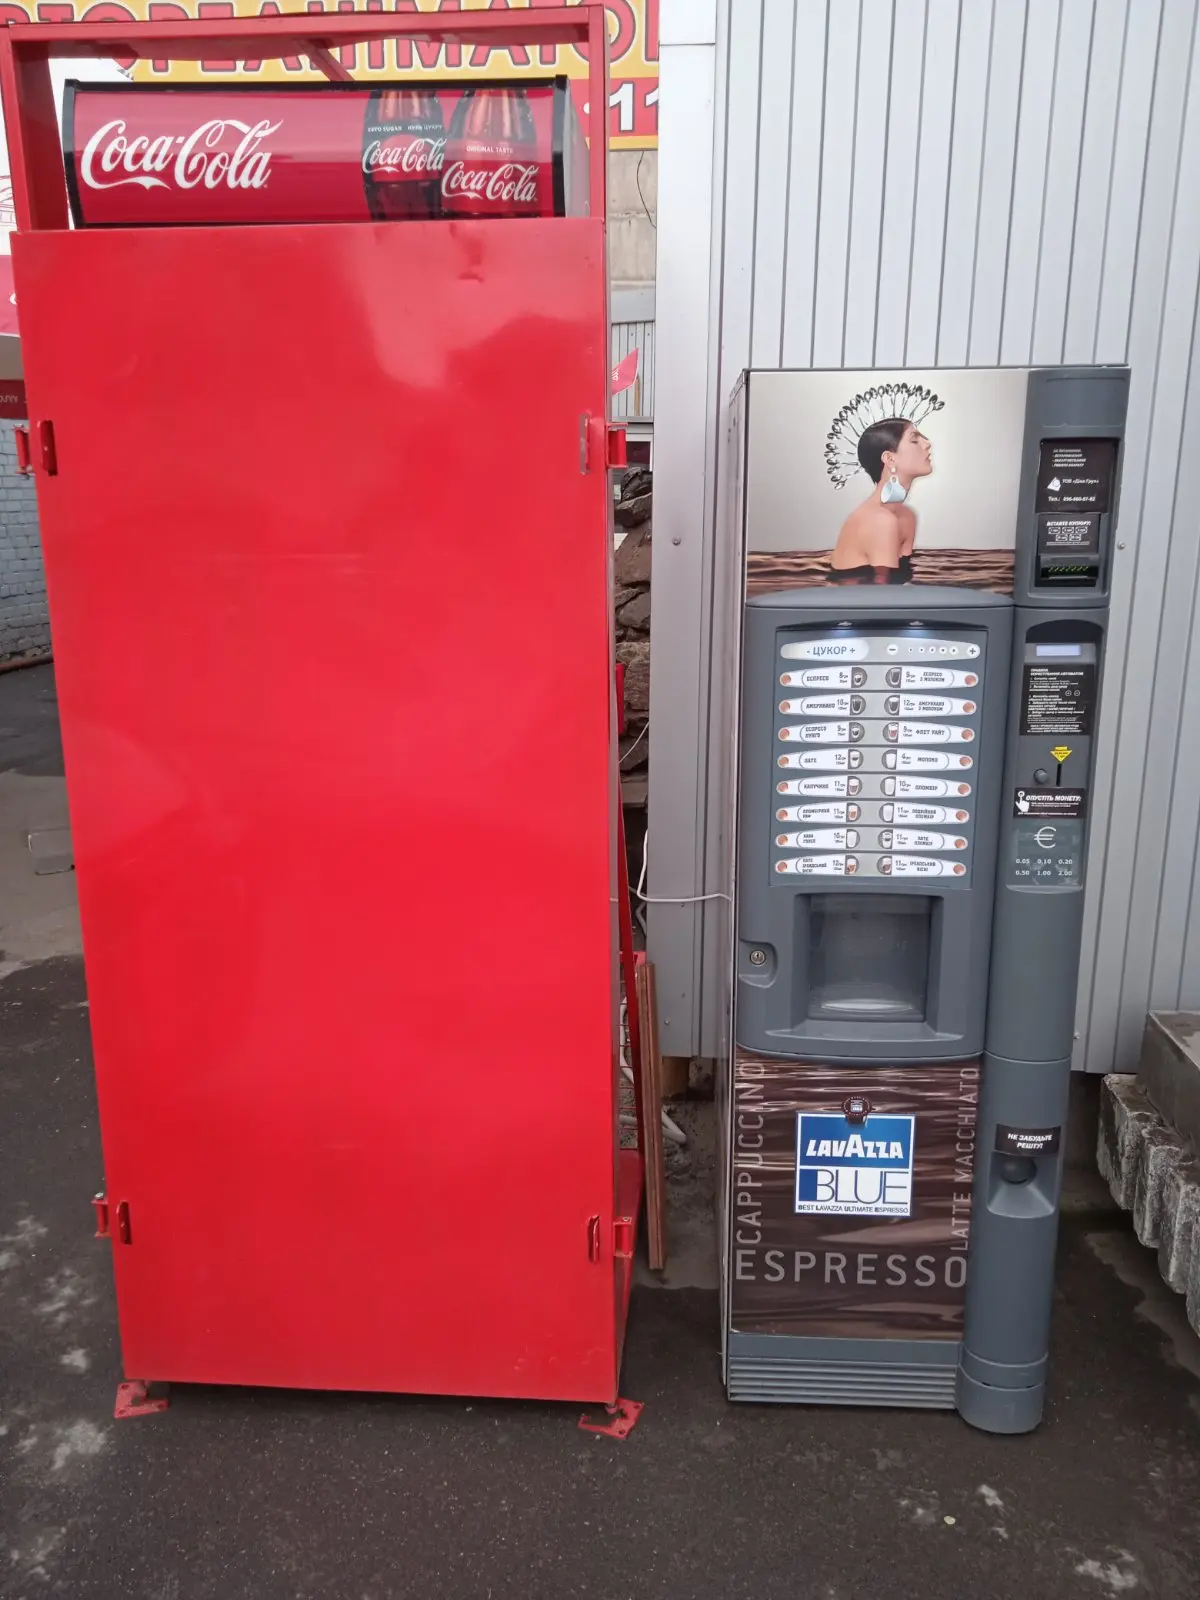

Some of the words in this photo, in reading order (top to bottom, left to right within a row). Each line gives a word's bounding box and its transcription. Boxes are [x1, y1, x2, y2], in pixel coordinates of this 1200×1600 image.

[81, 120, 283, 190] Coca-Cola
[362, 138, 447, 174] Coca-Cola
[441, 161, 539, 201] Coca-Cola
[813, 646, 847, 656] ЦУКОР
[954, 1067, 979, 1183] MACCHIATO
[1018, 1134, 1053, 1142] ЗАБУДЬТЕ
[736, 1062, 765, 1245] CAPPUCCINO
[806, 1134, 904, 1158] LAVAZZA
[799, 1169, 909, 1204] BLUE
[951, 1192, 971, 1250] LATTE
[736, 1250, 967, 1288] ESPRESSO
